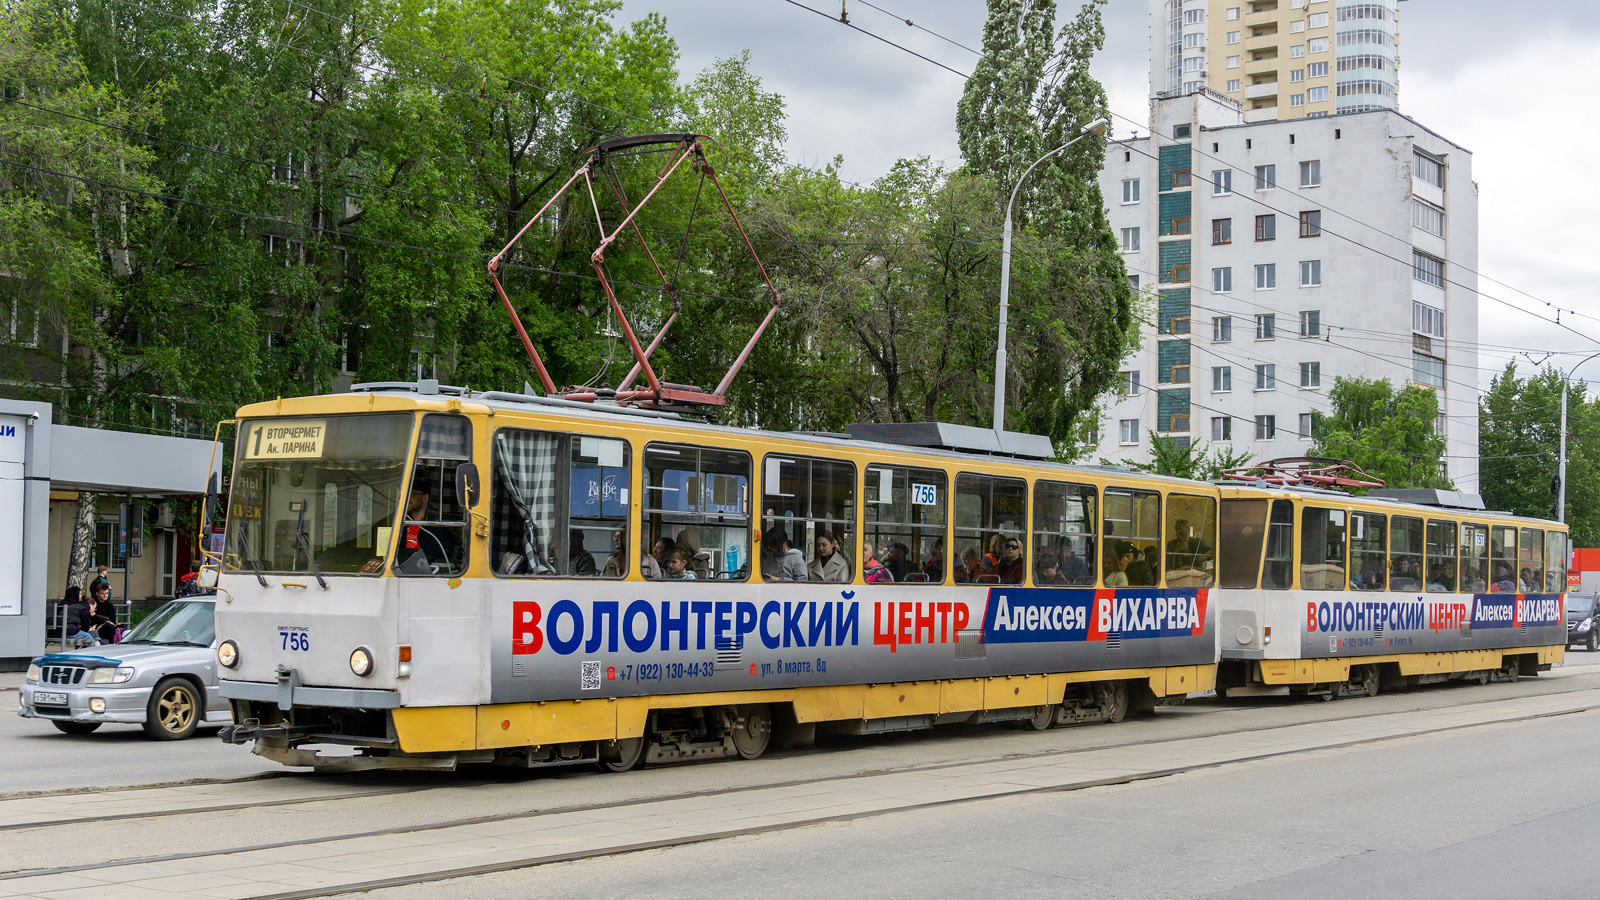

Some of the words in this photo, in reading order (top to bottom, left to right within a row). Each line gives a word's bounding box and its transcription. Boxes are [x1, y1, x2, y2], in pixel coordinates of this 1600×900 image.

[254, 426, 263, 456] 1
[267, 427, 321, 439] ВТОРЧЕРМЕТ
[266, 443, 279, 453] Ак.
[282, 442, 316, 453] ПАРИНА
[915, 485, 934, 503] 756
[512, 590, 859, 655] ВОЛОНТЕРСКИЙ
[873, 601, 970, 653] ЦЕНТР
[993, 595, 1087, 631] Алексея
[1098, 597, 1200, 633] ВИХАРЕВА
[1307, 596, 1425, 632] ВОЛОНТЕРСКИЙ
[1428, 603, 1466, 634] ЦЕНТР
[1475, 599, 1513, 621] Алексея
[1517, 599, 1560, 622] ВИХАРЕВА
[280, 632, 309, 651] 756
[620, 664, 633, 680] +7
[635, 663, 662, 683] (922)
[666, 662, 714, 679] 130-44-33
[761, 662, 774, 677] ул.
[777, 660, 782, 674] 8
[785, 661, 814, 675] марта,
[816, 658, 827, 674] 8д
